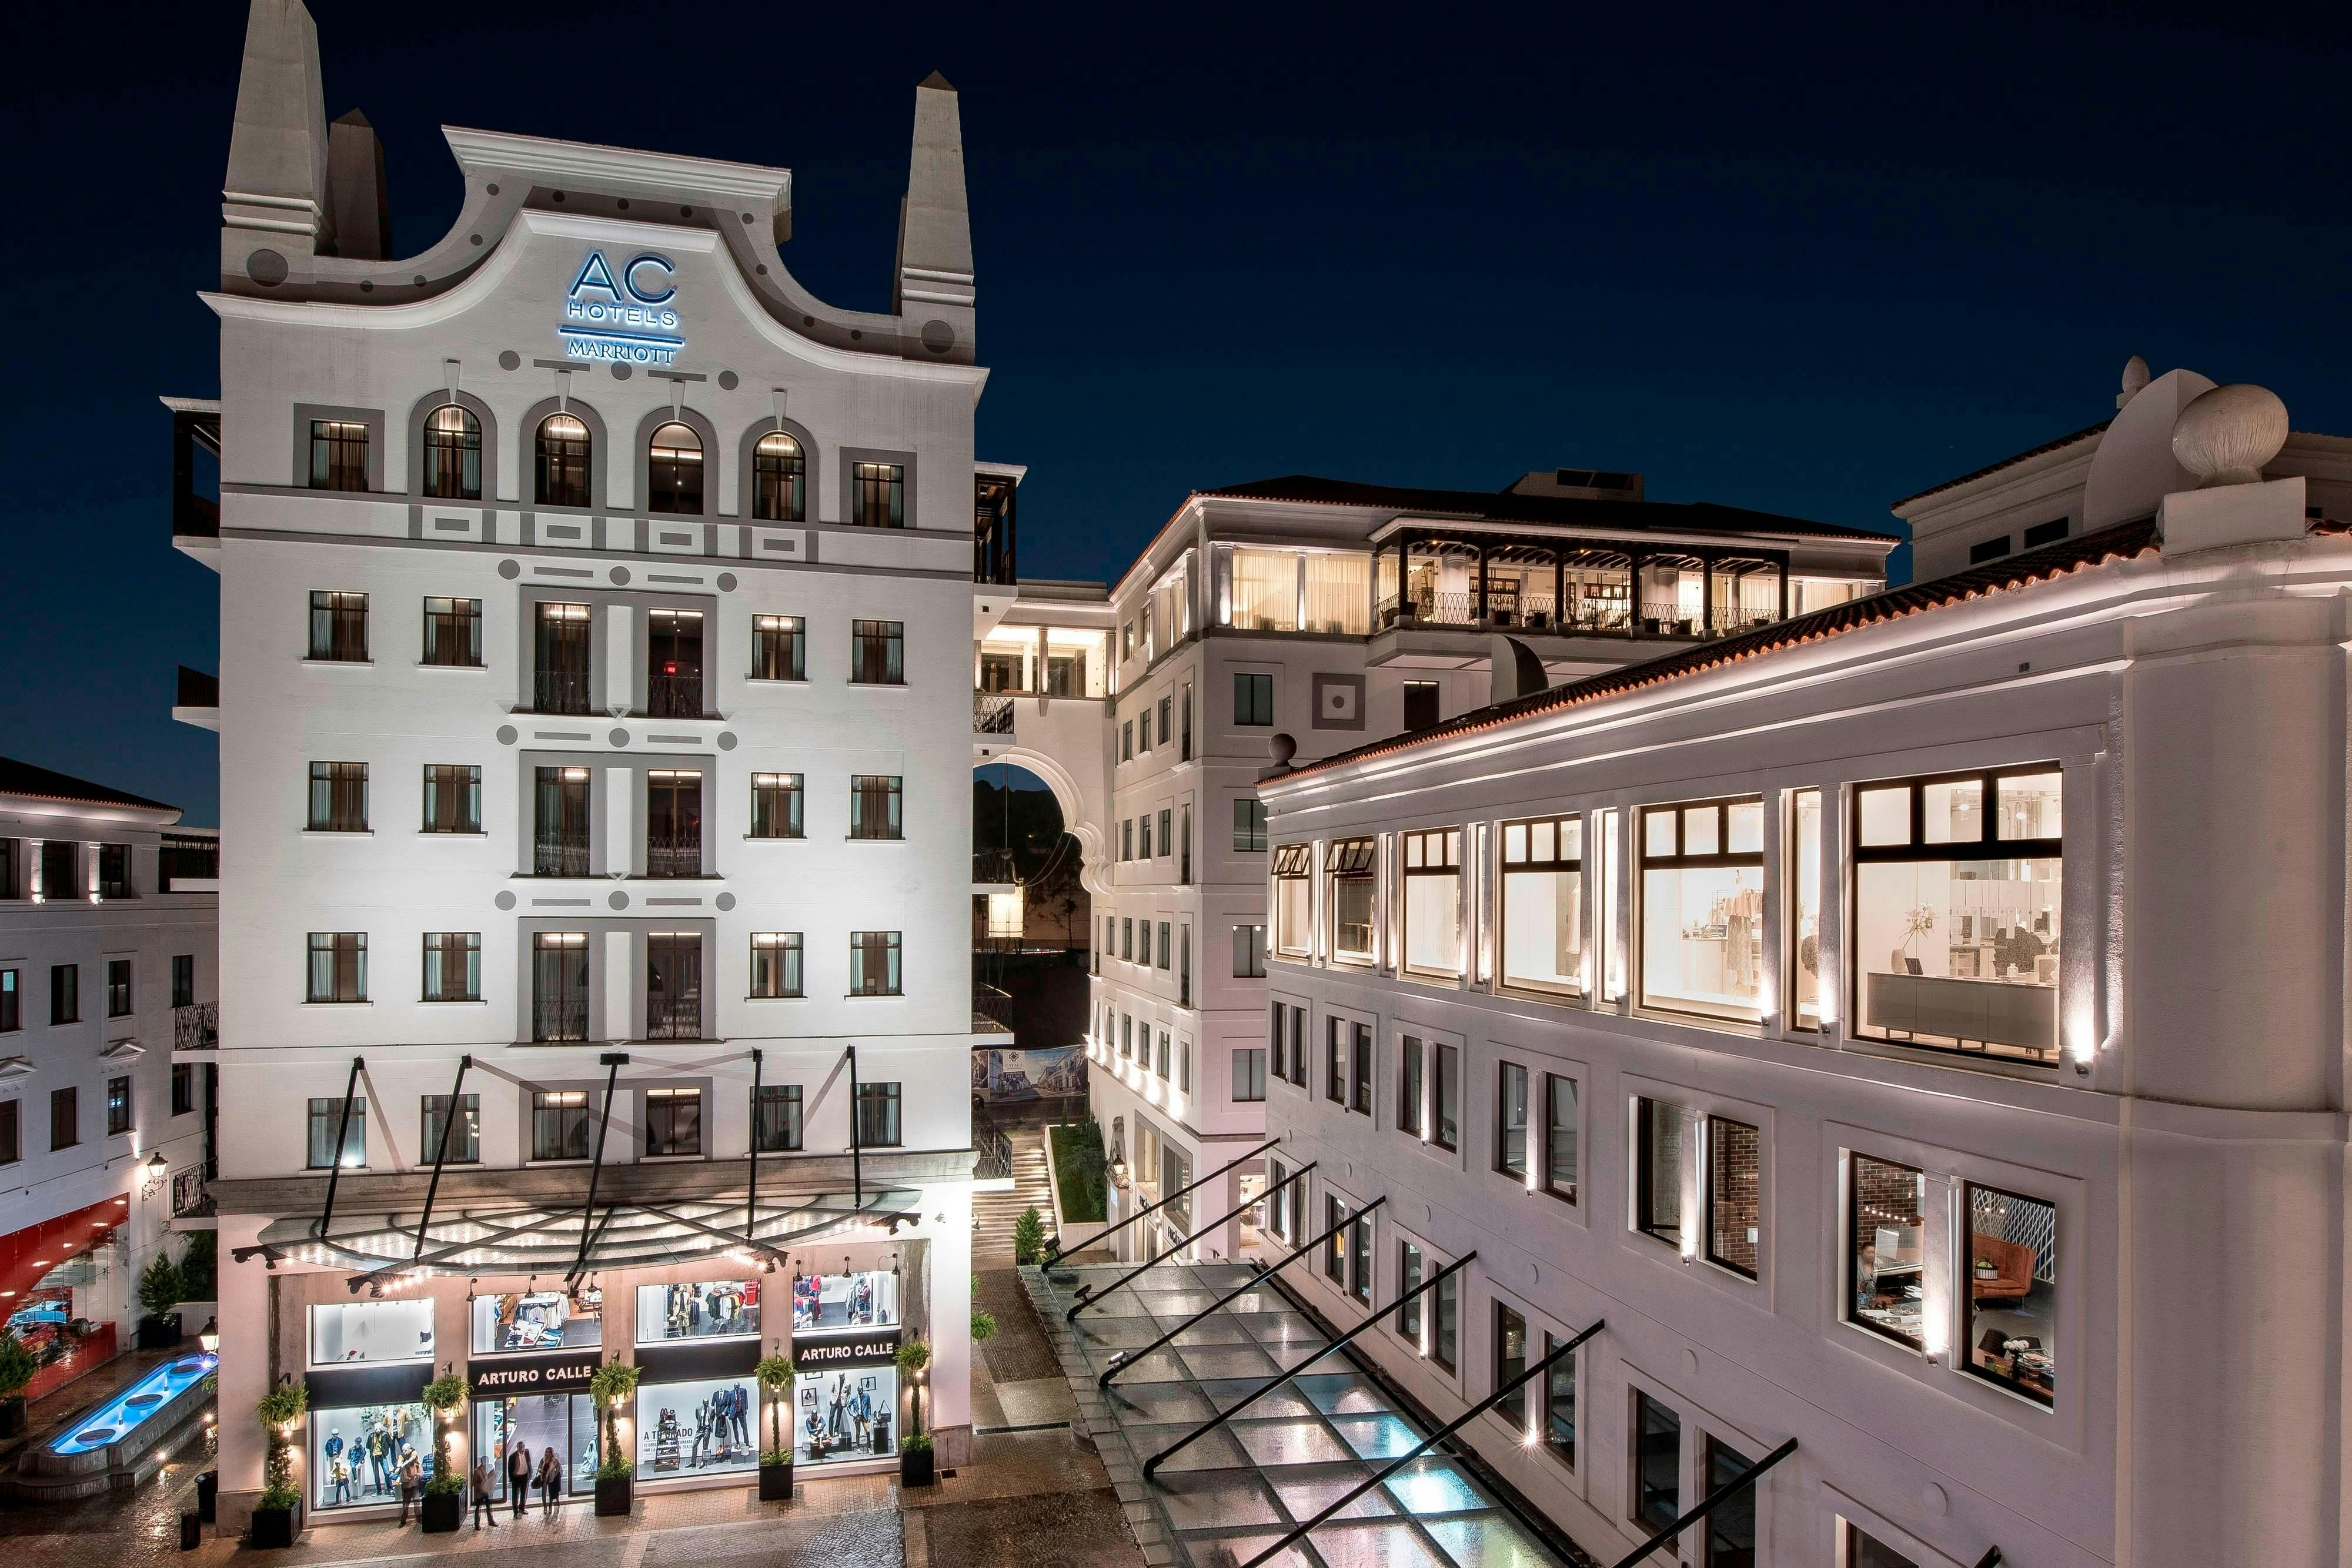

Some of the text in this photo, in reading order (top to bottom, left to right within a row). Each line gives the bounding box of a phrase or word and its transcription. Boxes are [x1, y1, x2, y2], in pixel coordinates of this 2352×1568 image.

[569, 253, 676, 305] AC
[569, 302, 674, 325] HOTELS
[568, 340, 674, 363] MARRIOTT
[801, 1343, 893, 1361] ARTURO CALLE
[478, 1366, 591, 1386] ARTURO CALLE
[644, 1432, 649, 1440] A
